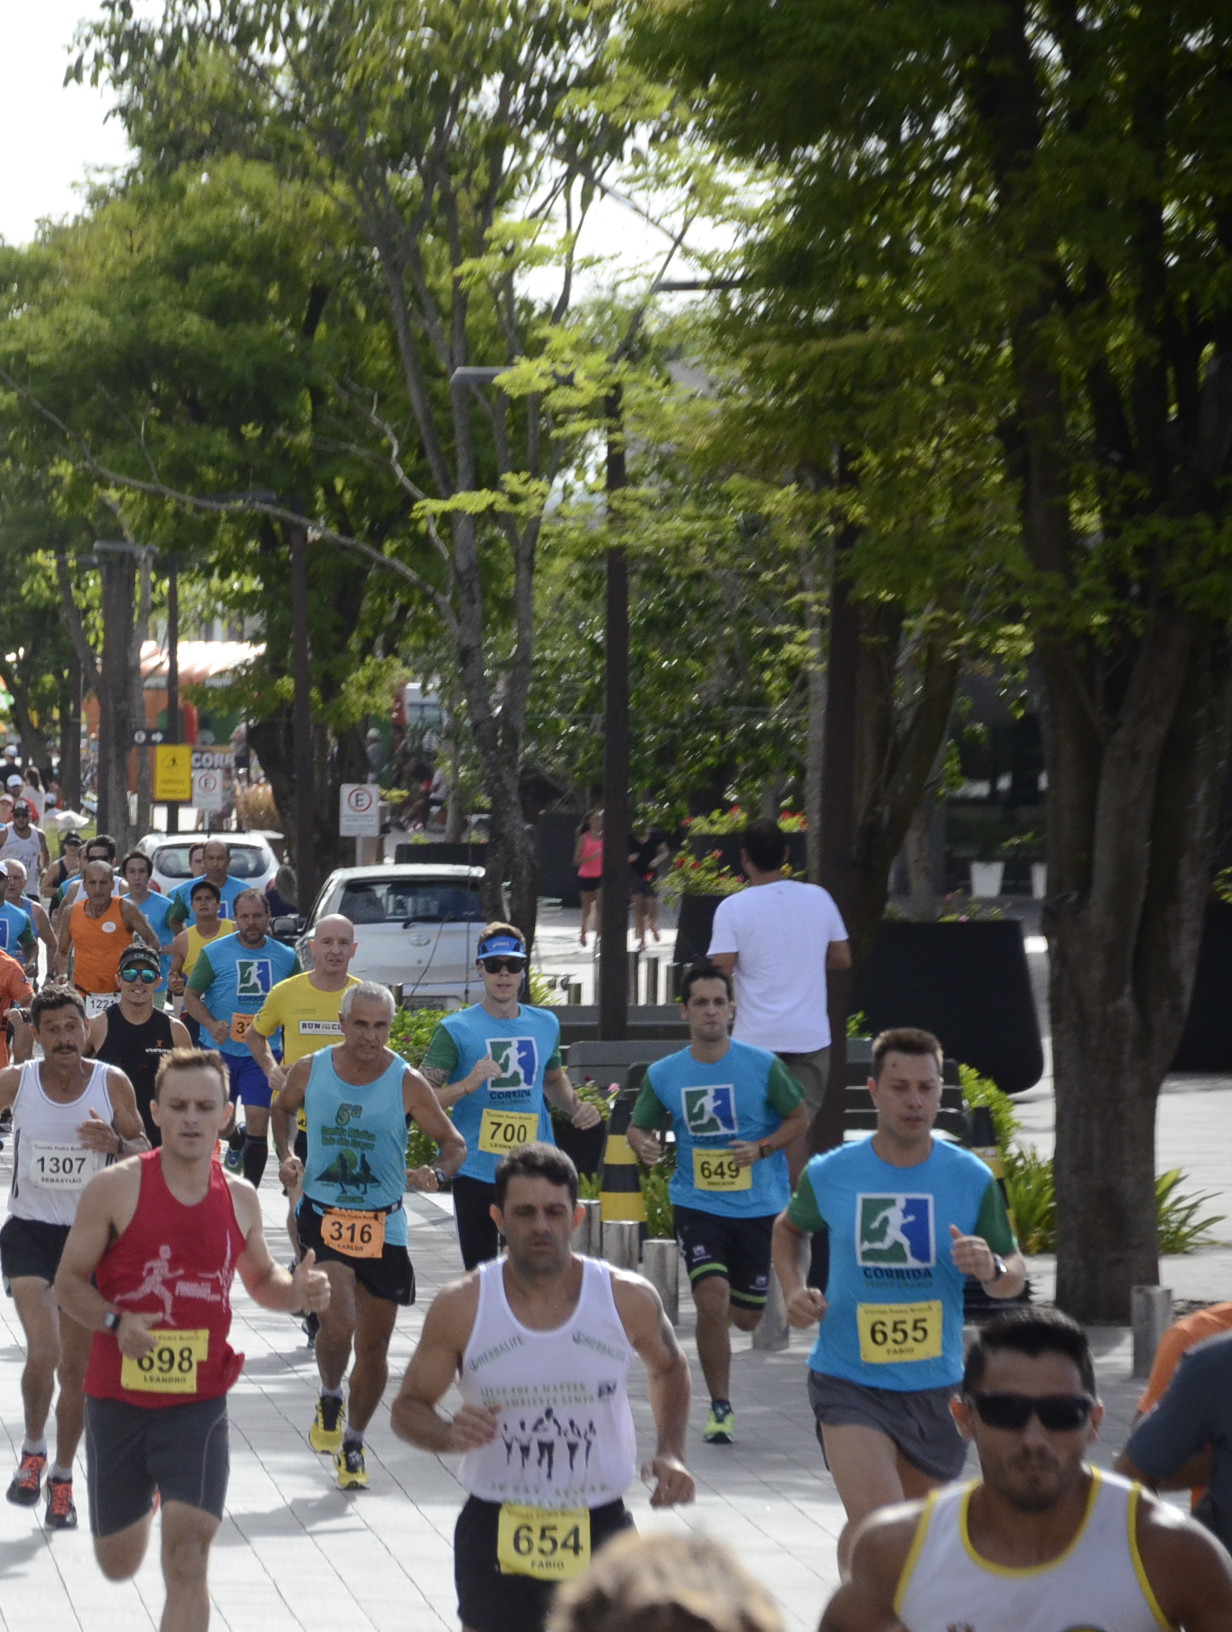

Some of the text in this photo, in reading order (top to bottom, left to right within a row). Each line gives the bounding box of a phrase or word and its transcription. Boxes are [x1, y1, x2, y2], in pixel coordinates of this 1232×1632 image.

[355, 793, 365, 807] E
[301, 1022, 321, 1030] RUN
[490, 1121, 528, 1143] 700
[36, 1156, 87, 1174] 1307
[700, 1161, 741, 1179] 649
[40, 1176, 82, 1184] SEBASTIÃO
[329, 1221, 373, 1244] 316
[864, 1266, 933, 1280] CORRIDA
[870, 1318, 928, 1346] 655
[137, 1347, 194, 1373] 698
[477, 1335, 525, 1367] HERBALIFE
[143, 1375, 186, 1384] LEANDRO
[512, 1524, 584, 1557] 654
[531, 1560, 565, 1570] FABIO
